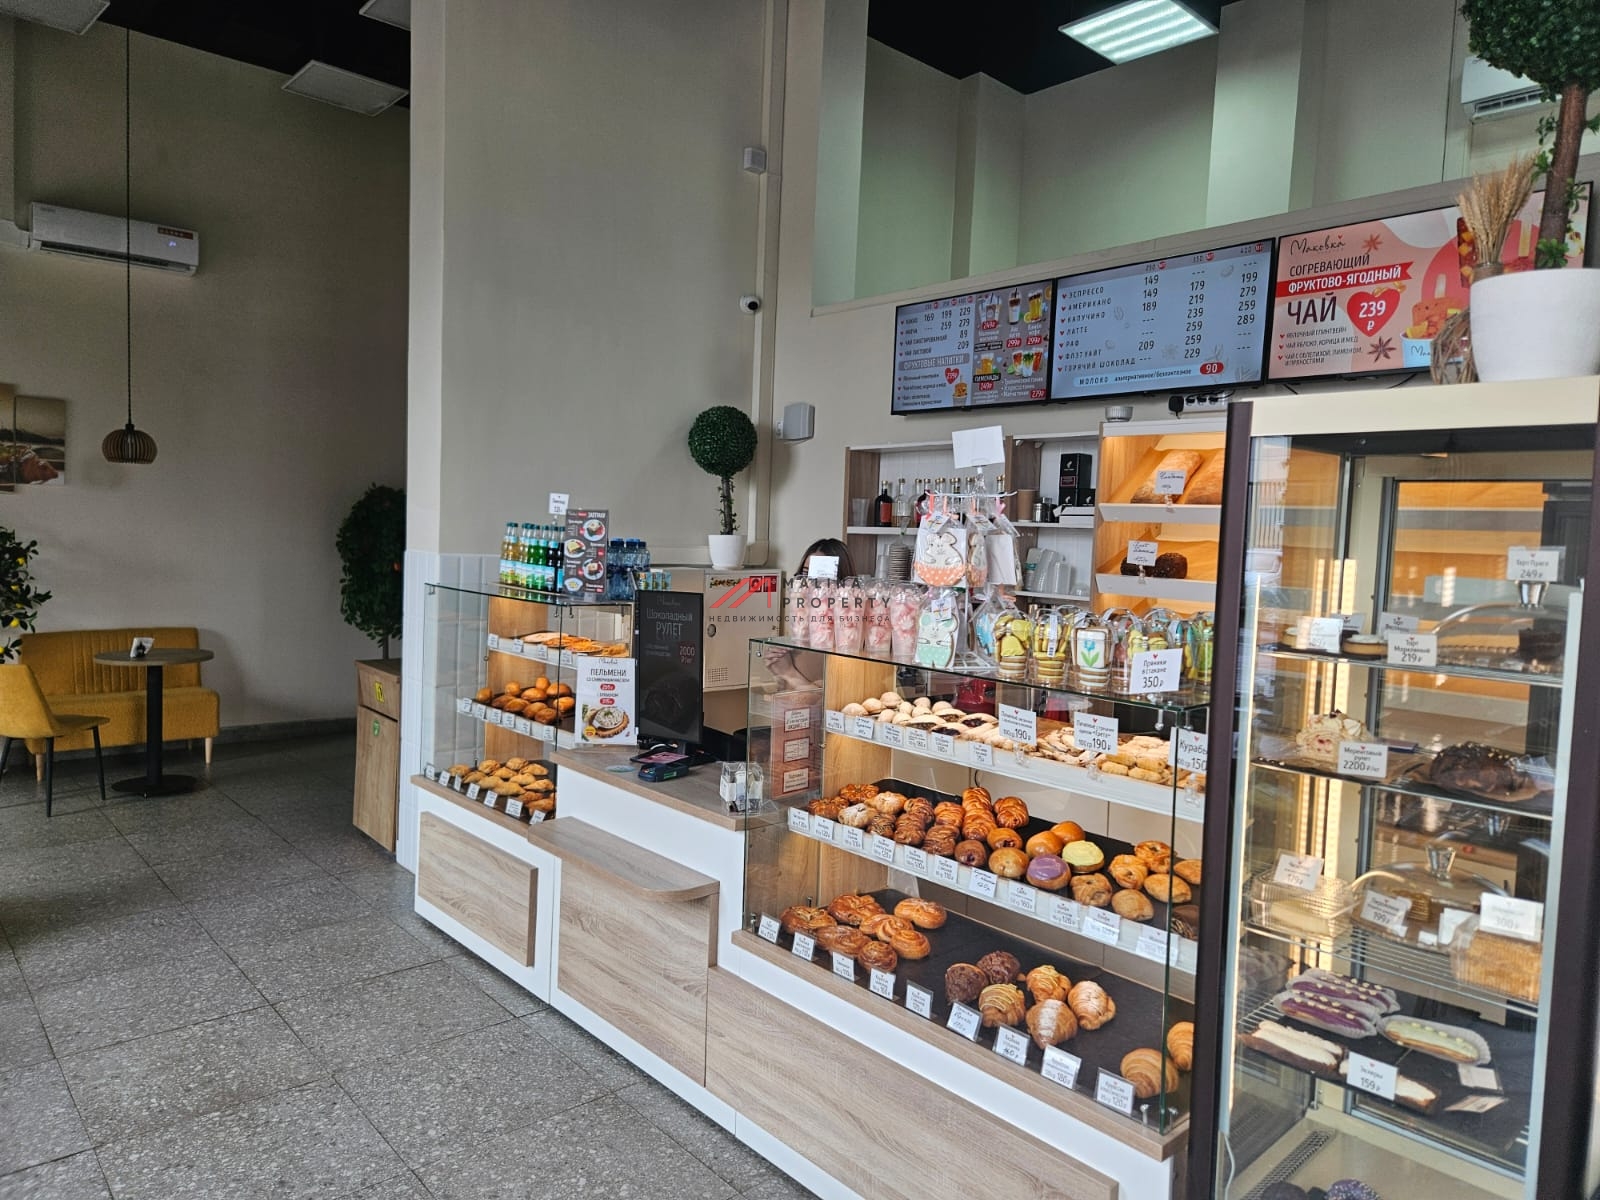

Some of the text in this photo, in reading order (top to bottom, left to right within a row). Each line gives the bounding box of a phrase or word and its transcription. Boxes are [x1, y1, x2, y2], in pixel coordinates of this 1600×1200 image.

[1289, 254, 1370, 277] СОГРЕВАЮЩИЙ
[1069, 274, 1159, 298] ЭСПРЕССО 149
[1288, 265, 1401, 293] ФРУКТОВО-ЯГОДНЫЙ
[1068, 271, 1258, 310] АМЕРИКАНО 149 179 199
[1067, 285, 1257, 323] КАПУЧИНО 189 219 279
[1287, 292, 1337, 325] ЧАЙ
[1359, 300, 1386, 318] 239
[924, 312, 935, 322] 169
[942, 309, 953, 319] 199
[959, 306, 971, 317] 229
[1066, 299, 1256, 335] ЛАТТЕ 239 259
[1186, 320, 1203, 332] 259
[1236, 313, 1255, 326] 289
[941, 321, 952, 331] 259
[959, 318, 970, 328] 279
[959, 330, 968, 339] 89
[1138, 340, 1155, 351] 209
[1185, 333, 1202, 346] 259
[957, 340, 969, 350] 209
[1064, 347, 1201, 372] ГОРЯЧИЙ ШОКОЛАД 229
[1079, 376, 1109, 385] МОЛОКО
[1205, 363, 1218, 374] 90
[646, 608, 693, 622] Шоколадный
[655, 621, 684, 636] РУЛЕТ
[590, 668, 627, 677] ПЕЛЬМЕНИ
[1143, 659, 1167, 668] Пряники
